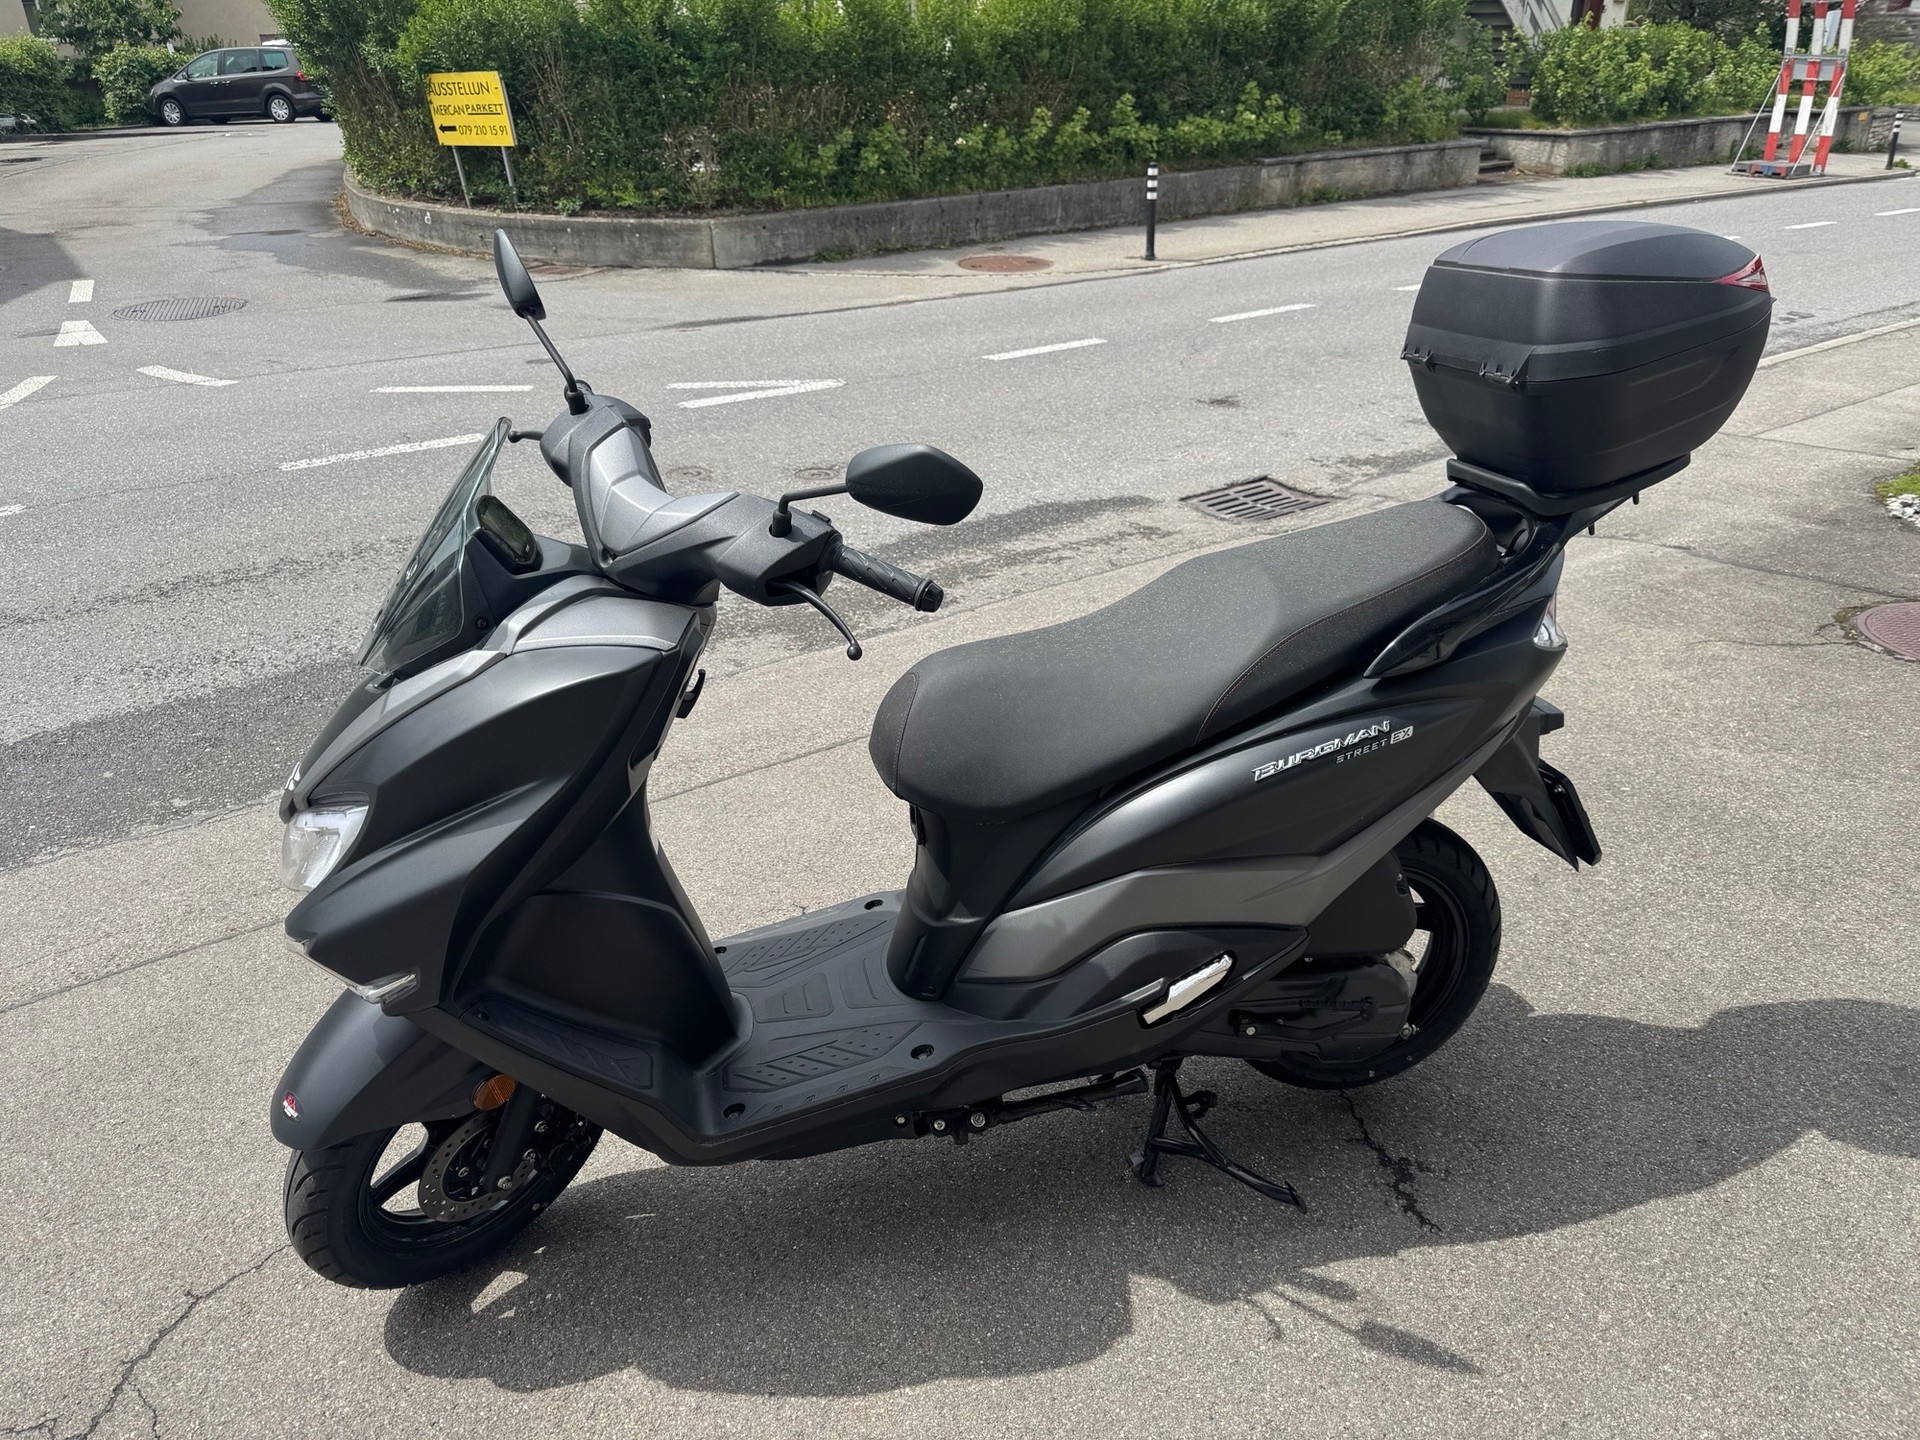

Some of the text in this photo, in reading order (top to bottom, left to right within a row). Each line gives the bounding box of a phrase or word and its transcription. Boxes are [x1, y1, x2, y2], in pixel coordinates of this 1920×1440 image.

[466, 103, 503, 115] PARKETT
[458, 125, 508, 136] 079 210 15 91
[1251, 720, 1390, 781] BURGMAN
[1336, 725, 1414, 764] STREET EX
